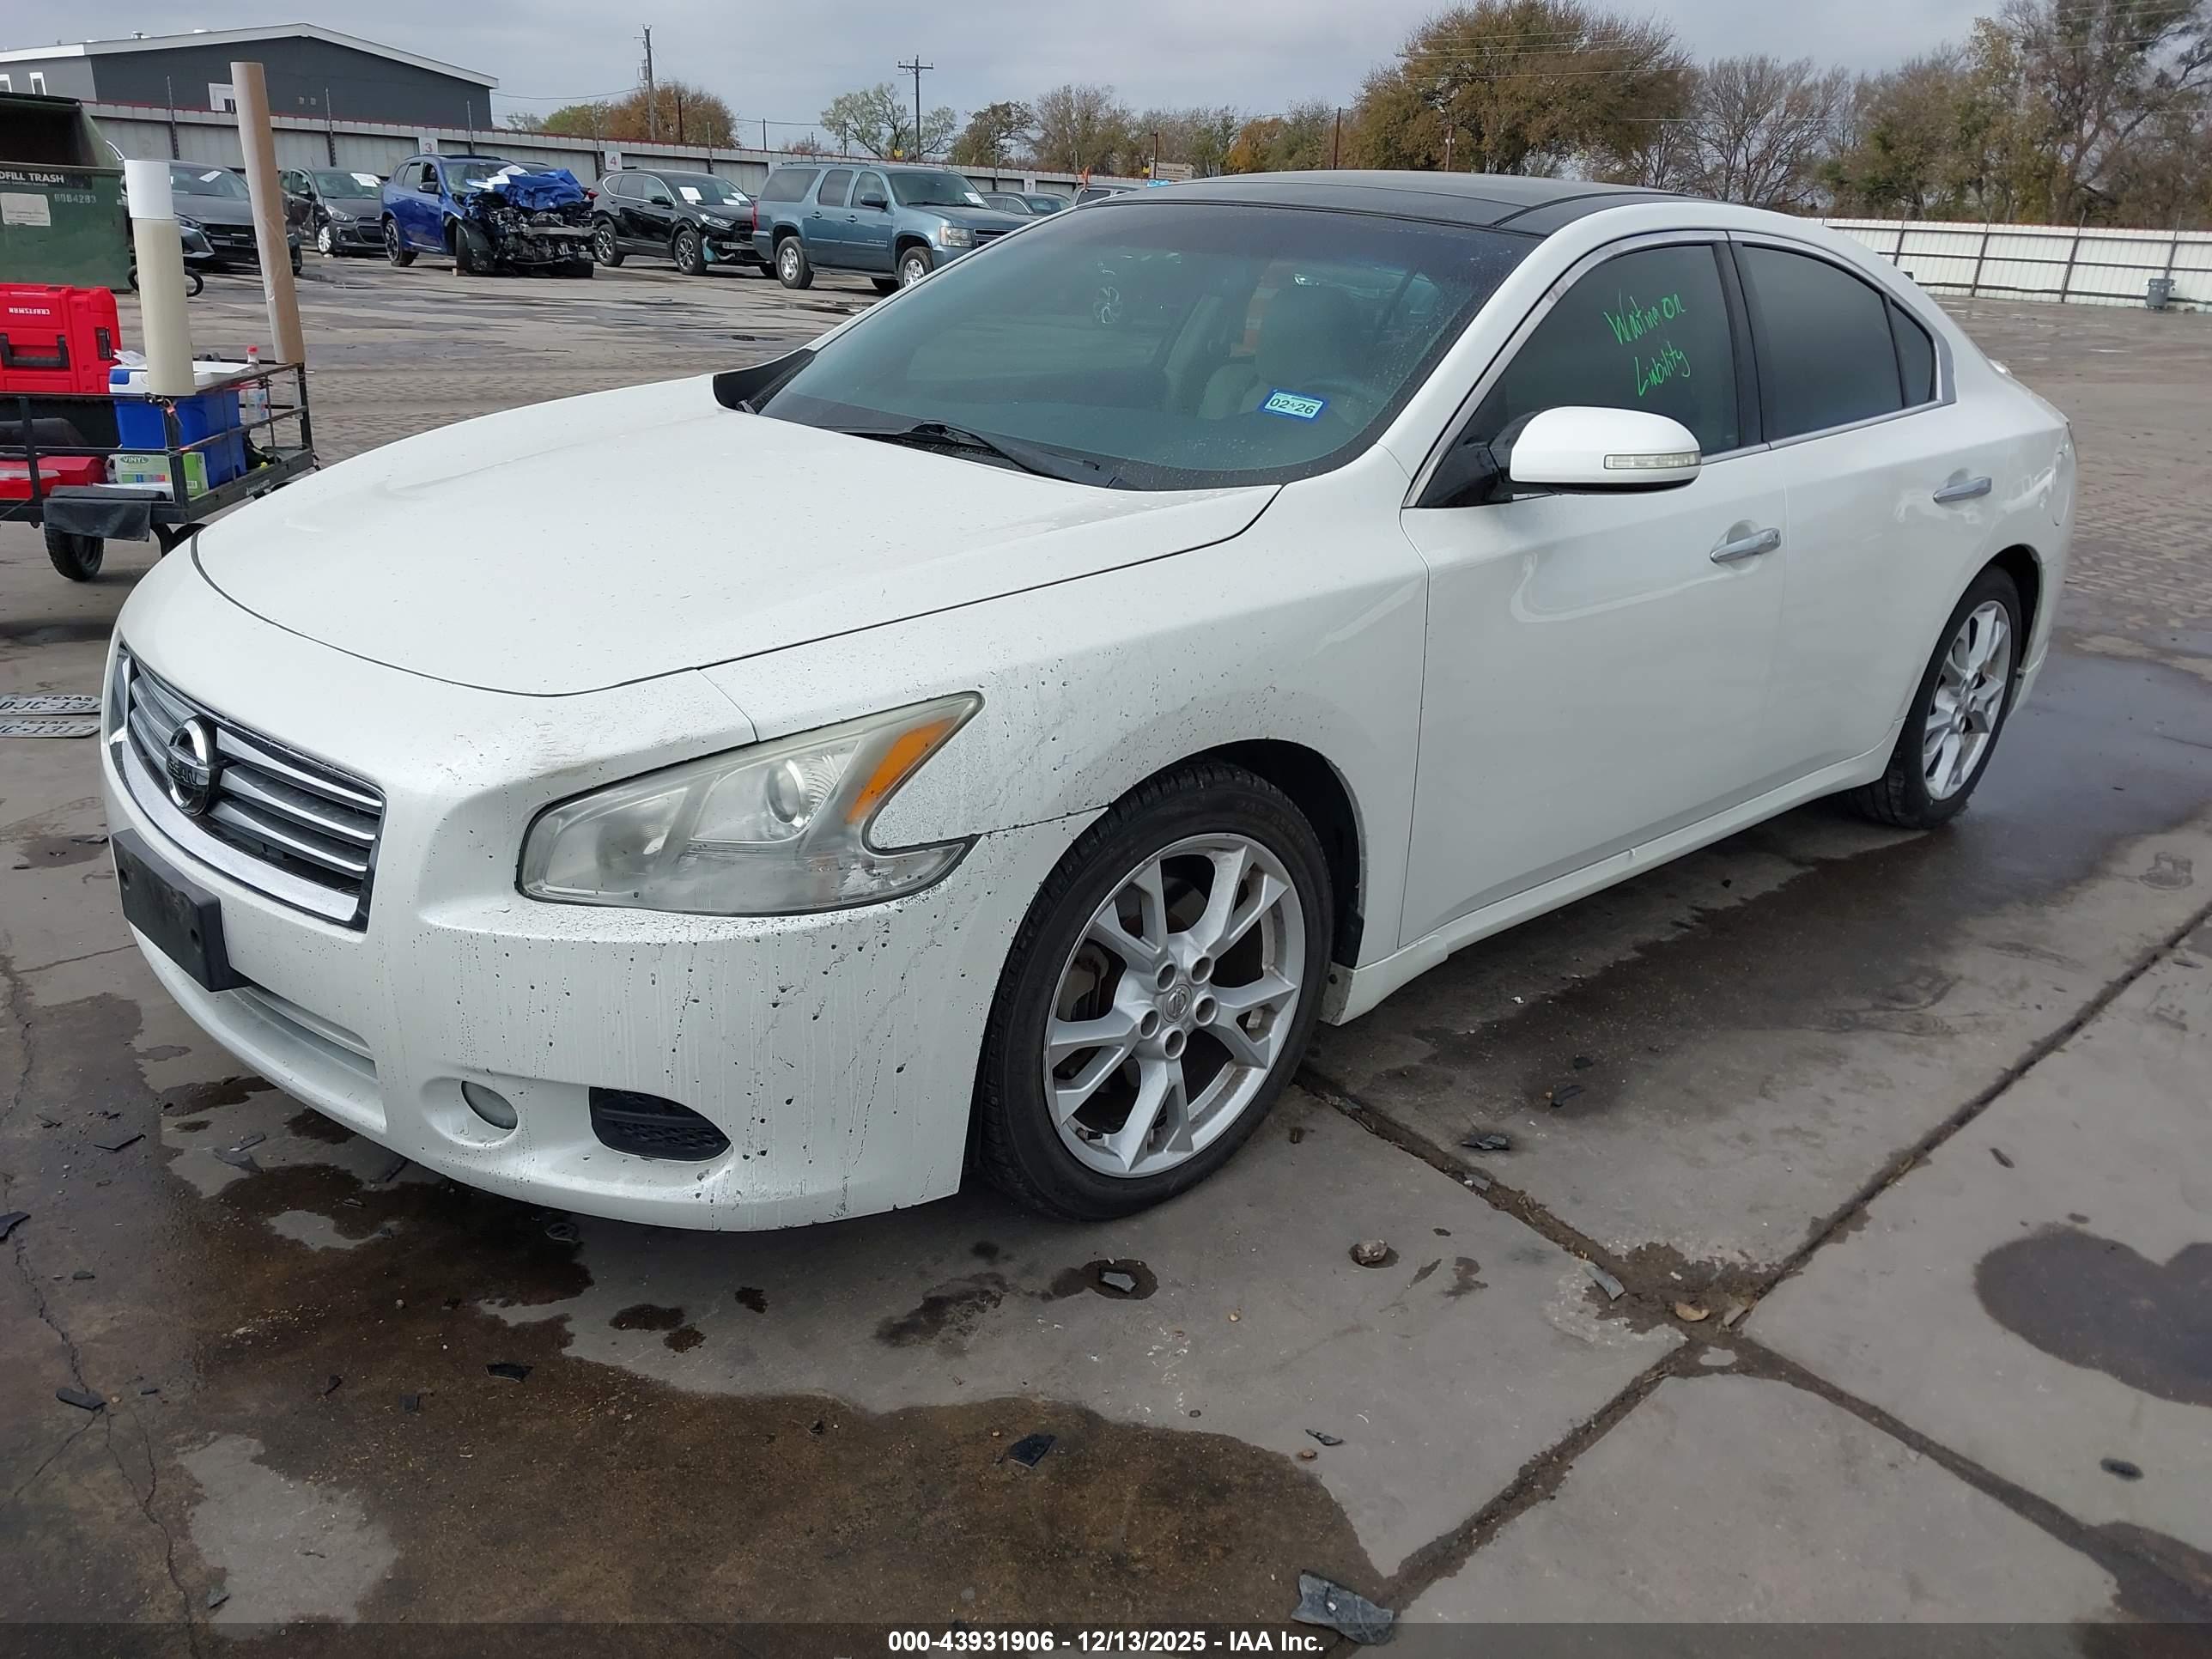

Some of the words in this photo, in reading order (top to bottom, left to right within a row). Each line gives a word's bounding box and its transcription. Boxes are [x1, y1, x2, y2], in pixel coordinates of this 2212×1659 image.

[425, 143, 434, 153] 3
[610, 155, 617, 166] 4
[28, 173, 64, 184] TRASH
